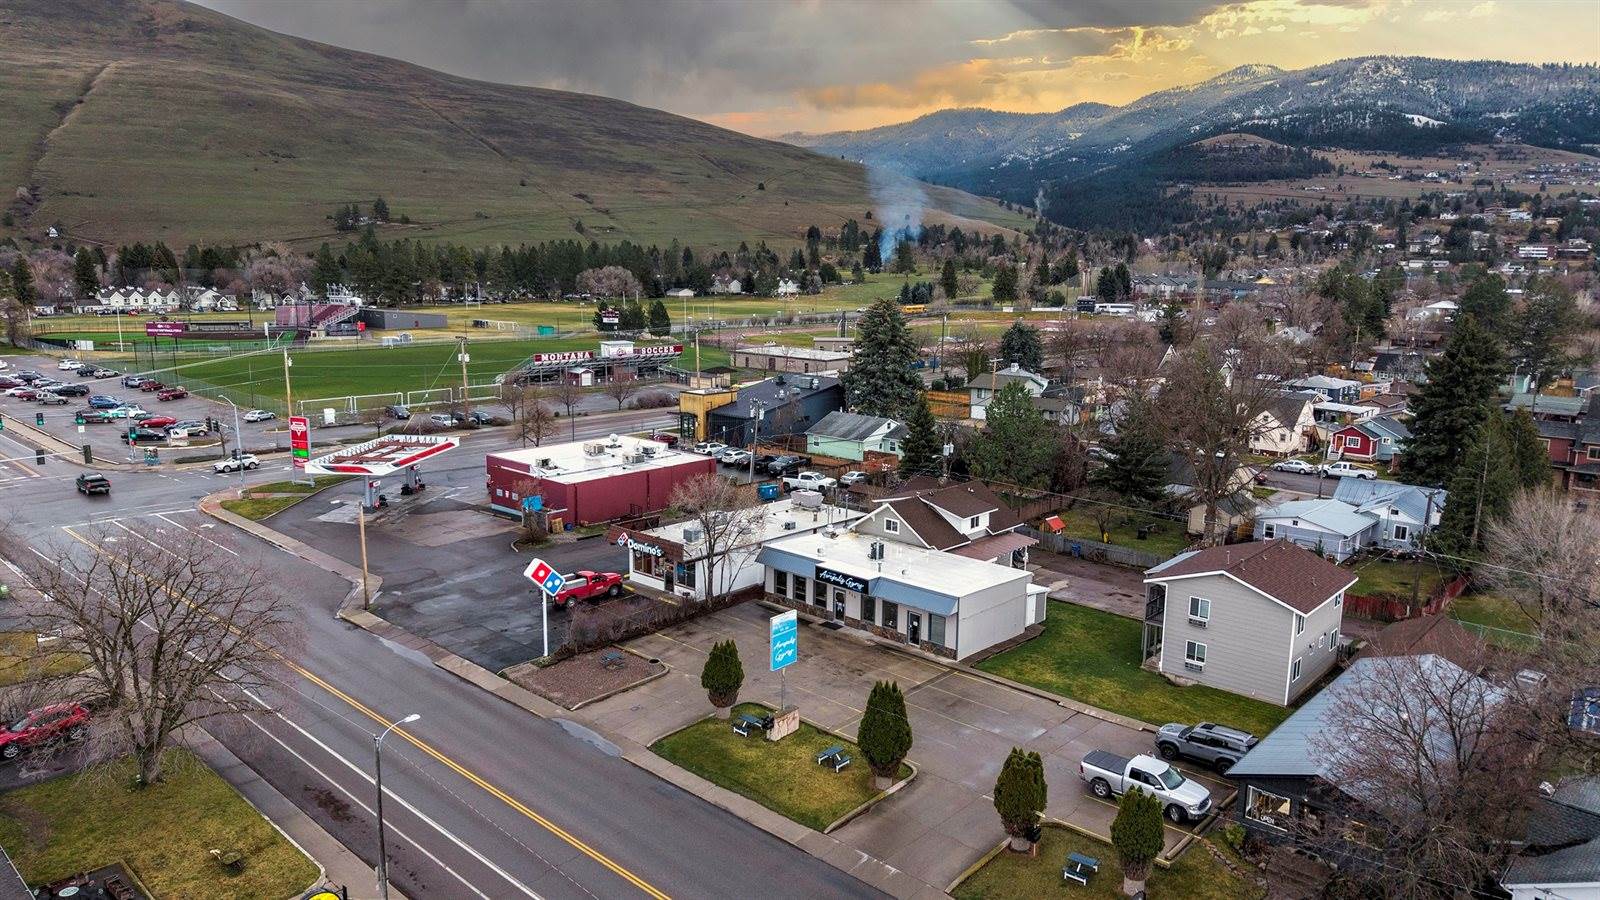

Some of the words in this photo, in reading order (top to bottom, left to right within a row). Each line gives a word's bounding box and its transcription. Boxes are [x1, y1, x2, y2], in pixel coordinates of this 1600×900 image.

[541, 352, 591, 361] MONTANA
[641, 346, 675, 355] SOCCER
[628, 539, 662, 557] Domino's
[1260, 815, 1275, 825] OPEN
